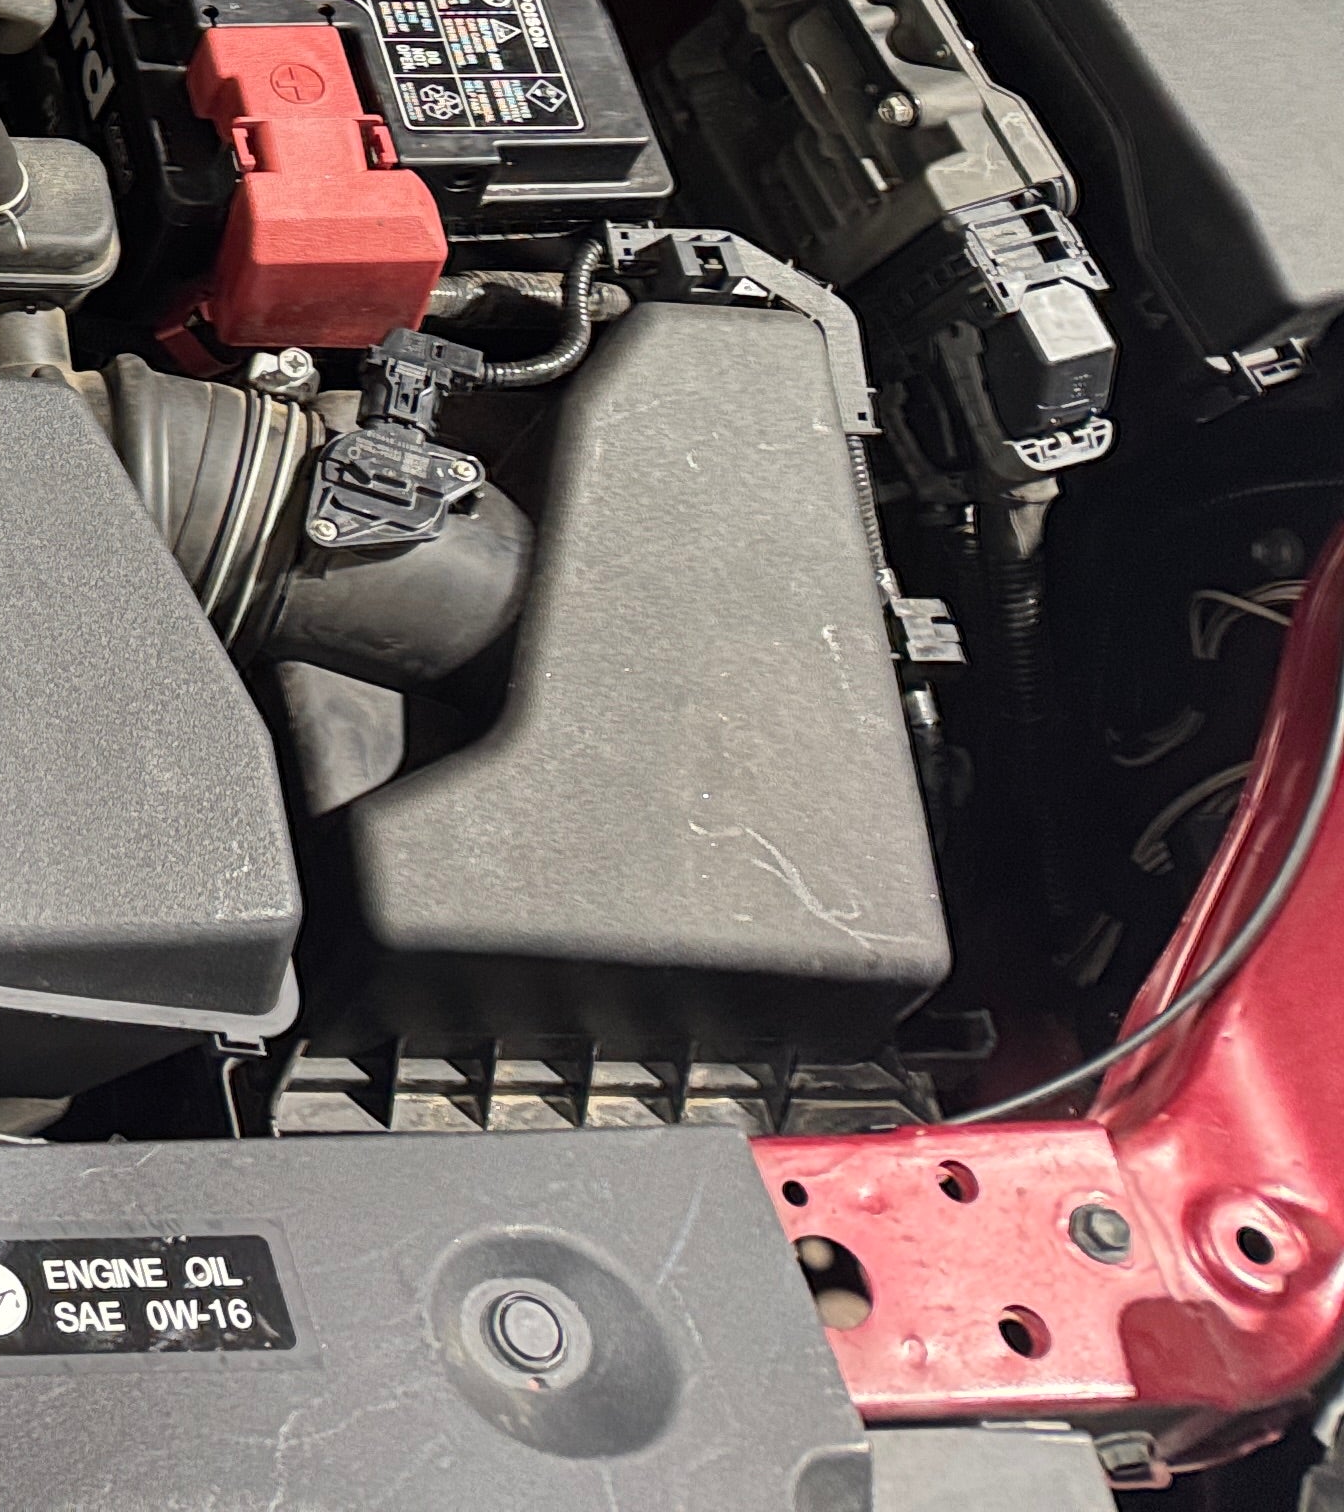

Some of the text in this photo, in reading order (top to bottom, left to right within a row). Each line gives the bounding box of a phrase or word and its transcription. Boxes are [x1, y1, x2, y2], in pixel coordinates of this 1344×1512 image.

[394, 44, 417, 72] OPEN.
[409, 47, 429, 66] NOT
[424, 50, 442, 64] DO
[42, 1256, 244, 1290] ENGINE OIL
[53, 1298, 253, 1333] SAE 0W-16
